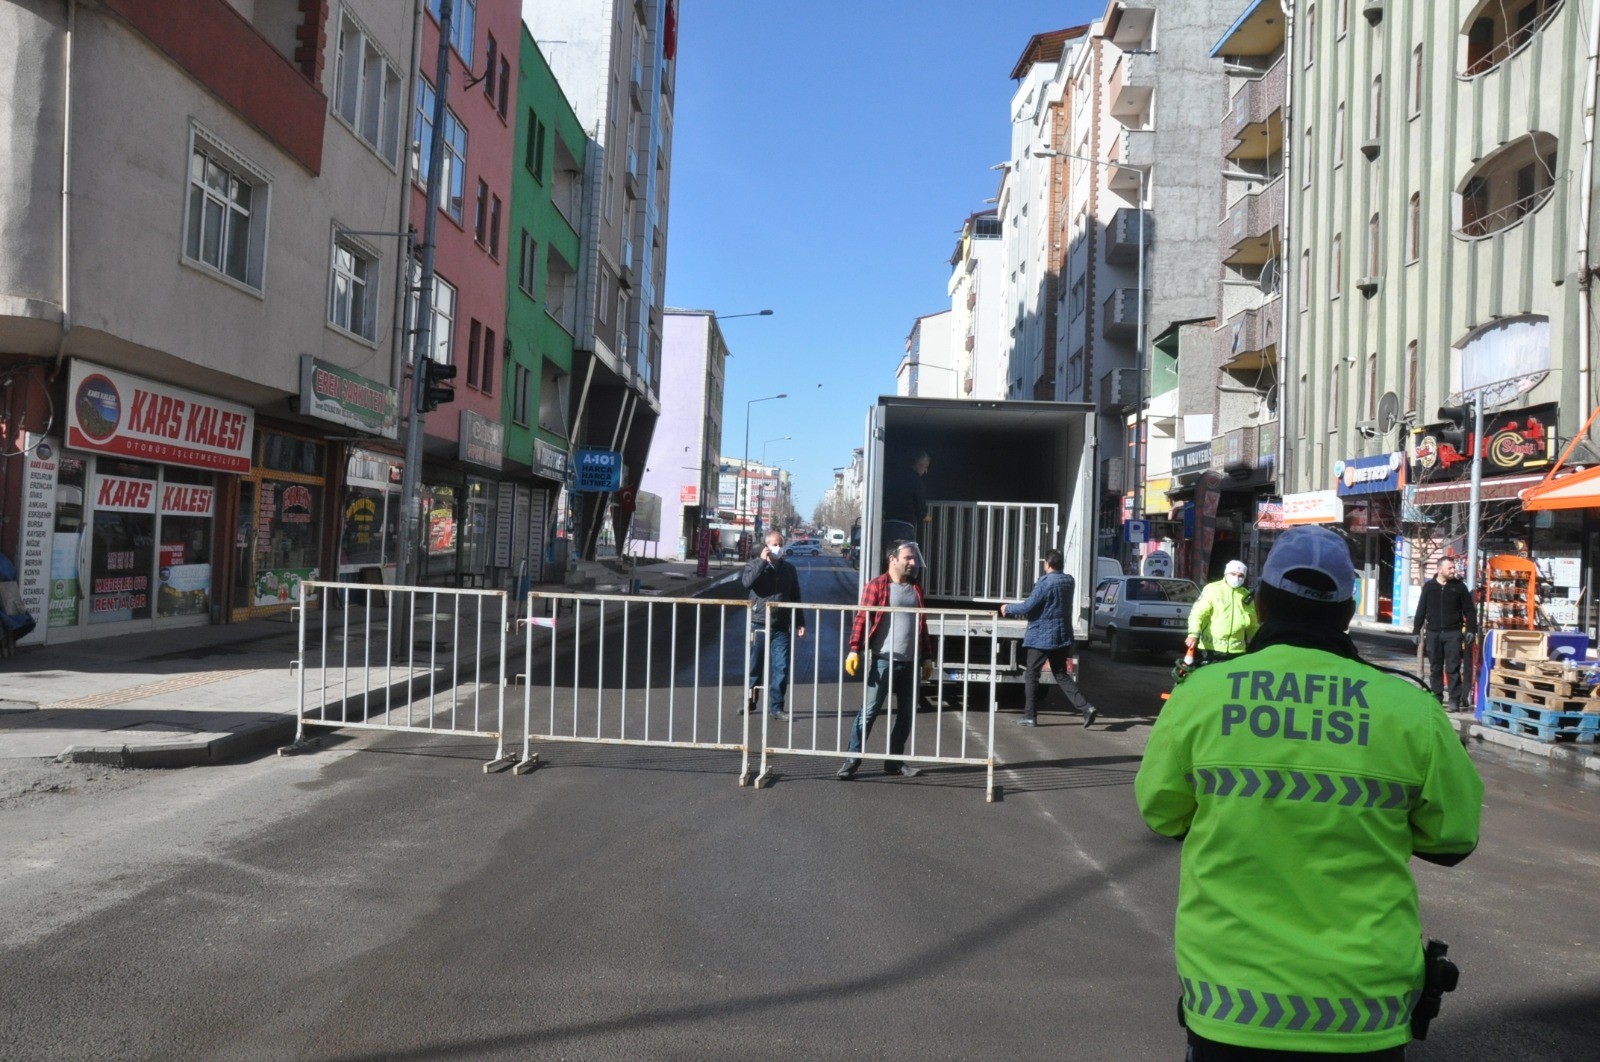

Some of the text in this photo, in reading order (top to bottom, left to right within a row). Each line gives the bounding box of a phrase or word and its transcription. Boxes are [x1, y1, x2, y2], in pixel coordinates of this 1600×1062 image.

[128, 389, 247, 451] KARS KALESİ
[126, 441, 167, 454] OTOBÜS
[1501, 439, 1535, 455] Simit
[582, 465, 612, 473] HARCA
[582, 472, 612, 480] HARCA
[97, 478, 213, 513] KARS KALESİ
[28, 501, 48, 509] ANKARA
[27, 520, 43, 528] BURSA
[25, 549, 42, 557] ADANA
[134, 576, 148, 590] OTO
[94, 594, 147, 612] RENT A CAR
[986, 671, 1000, 680] 28
[1227, 670, 1369, 709] TRAFİK
[1221, 703, 1370, 746] POLİSİ
